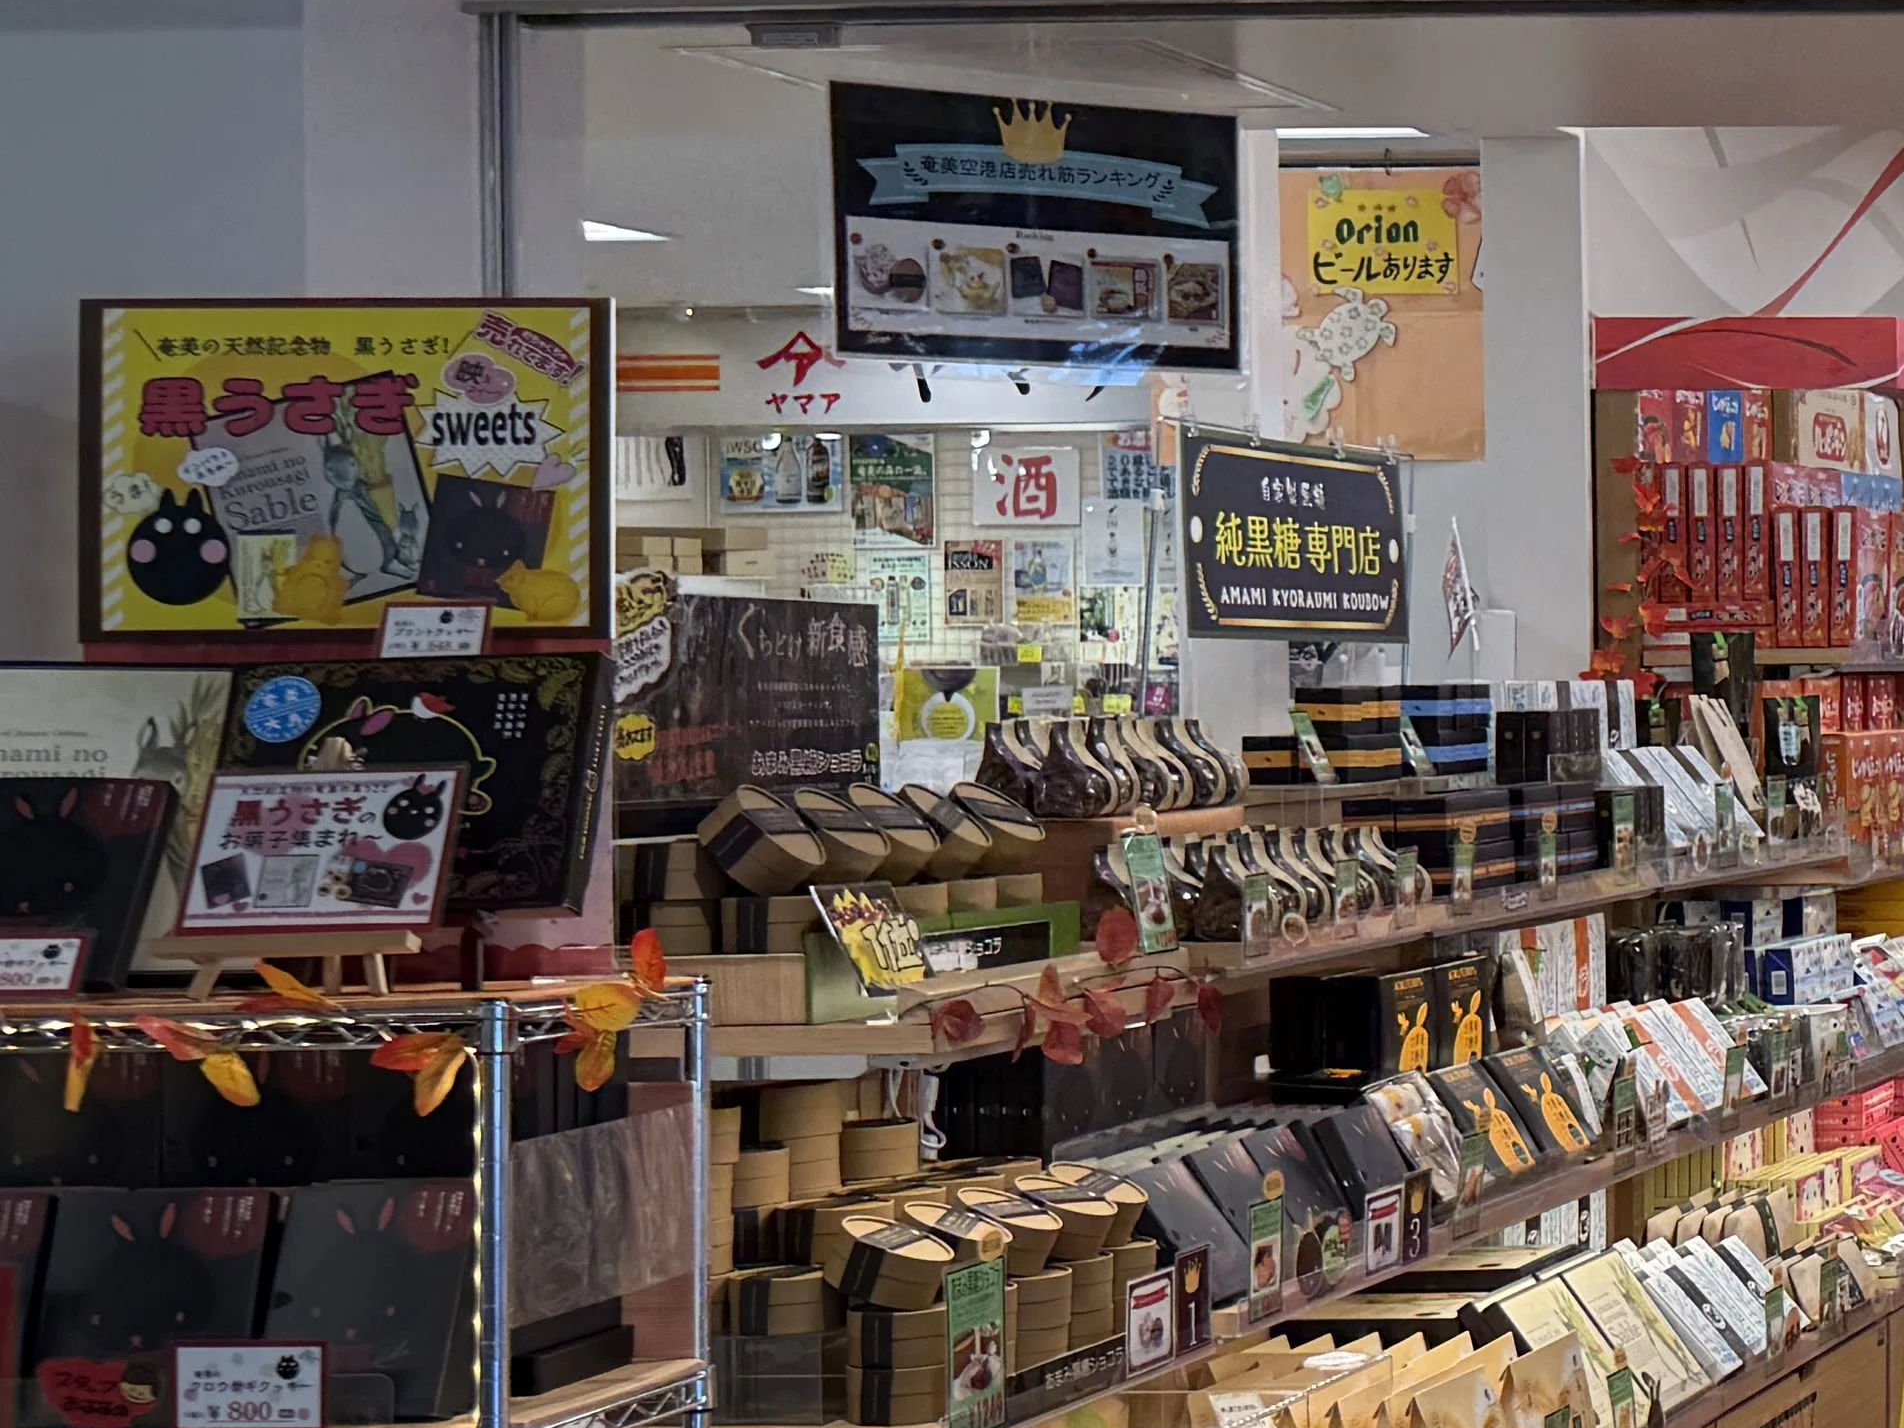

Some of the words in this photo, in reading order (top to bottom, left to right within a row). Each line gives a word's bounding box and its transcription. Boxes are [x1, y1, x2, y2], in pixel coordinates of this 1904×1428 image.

[1335, 217, 1419, 246] Orion
[1313, 253, 1455, 285] ビールあります
[141, 372, 420, 438] 黒うさぎ
[432, 409, 536, 447] sweets
[997, 453, 1059, 519] 酒
[1215, 511, 1381, 576] 純黒糖専門店
[1220, 586, 1267, 606] AMAMI
